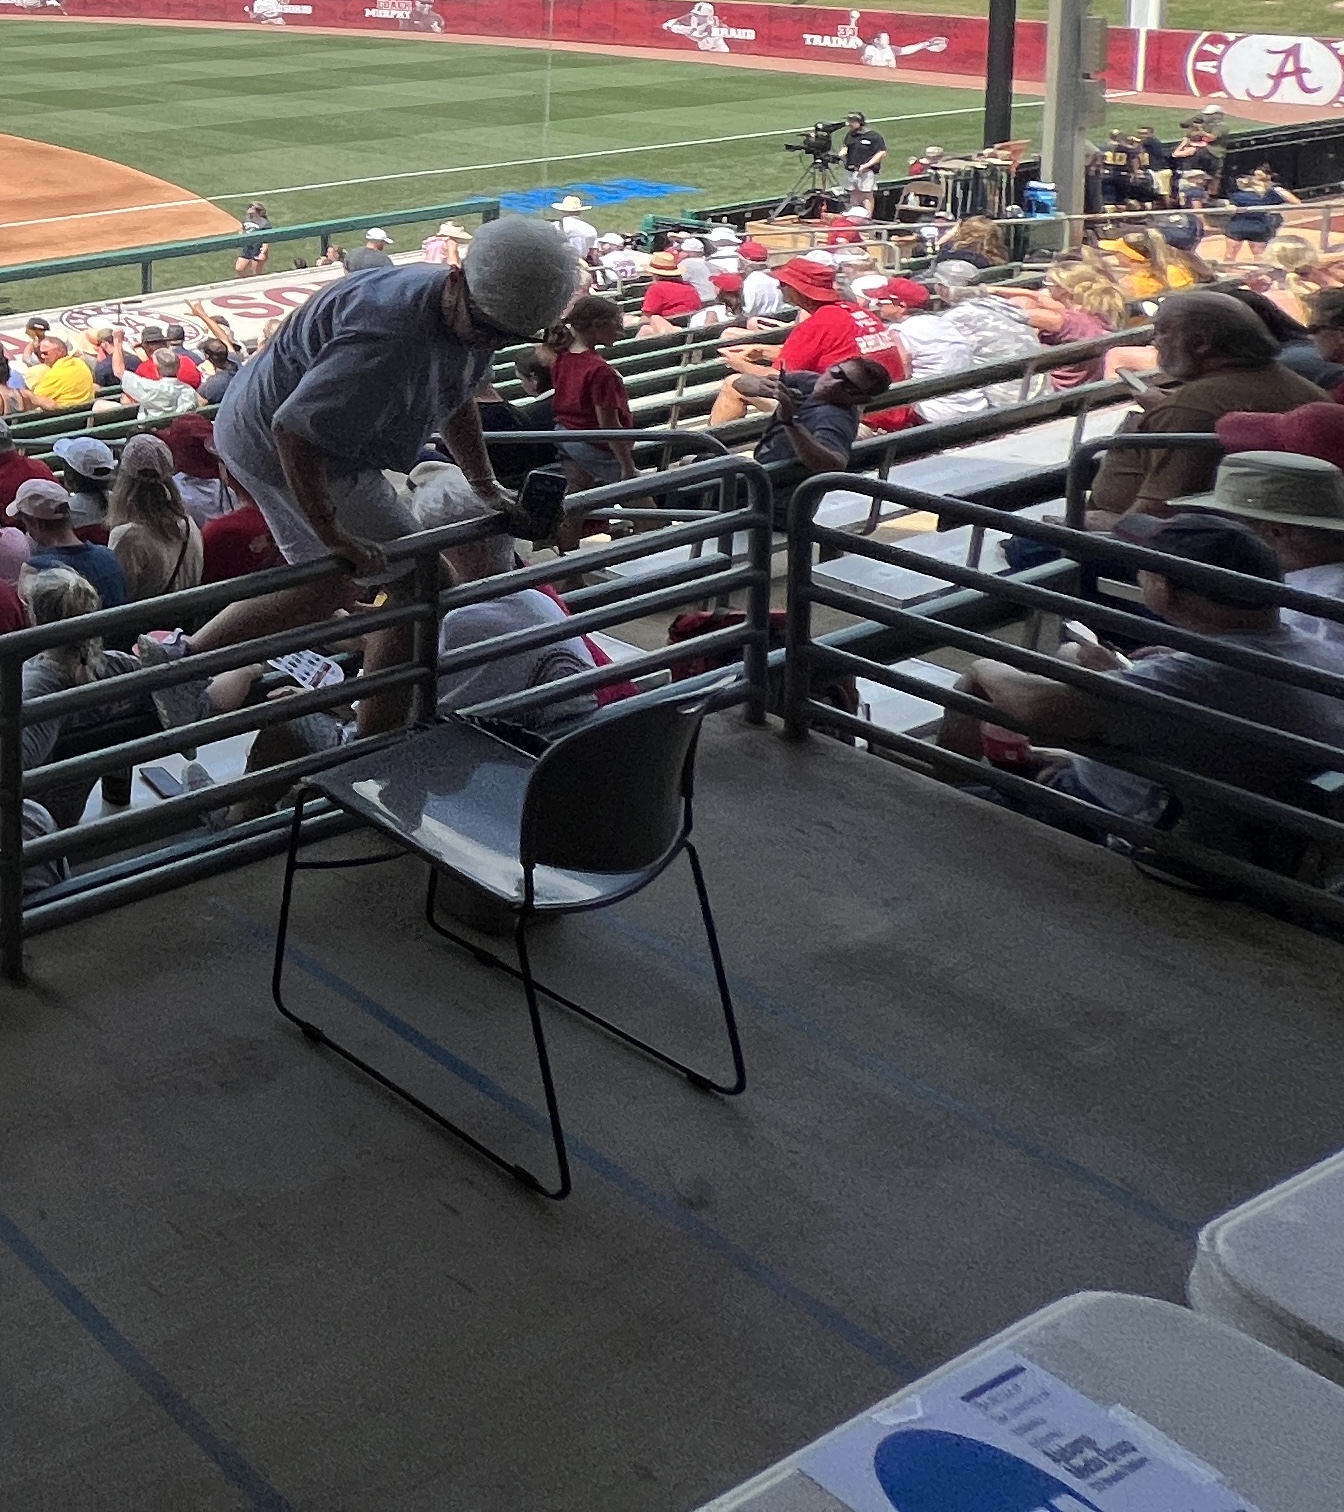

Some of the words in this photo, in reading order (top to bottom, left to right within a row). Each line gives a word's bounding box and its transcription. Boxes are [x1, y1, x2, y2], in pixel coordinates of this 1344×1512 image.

[376, 0, 412, 11] COACH
[364, 7, 412, 20] MURPHY
[803, 33, 860, 50] TRAINA
